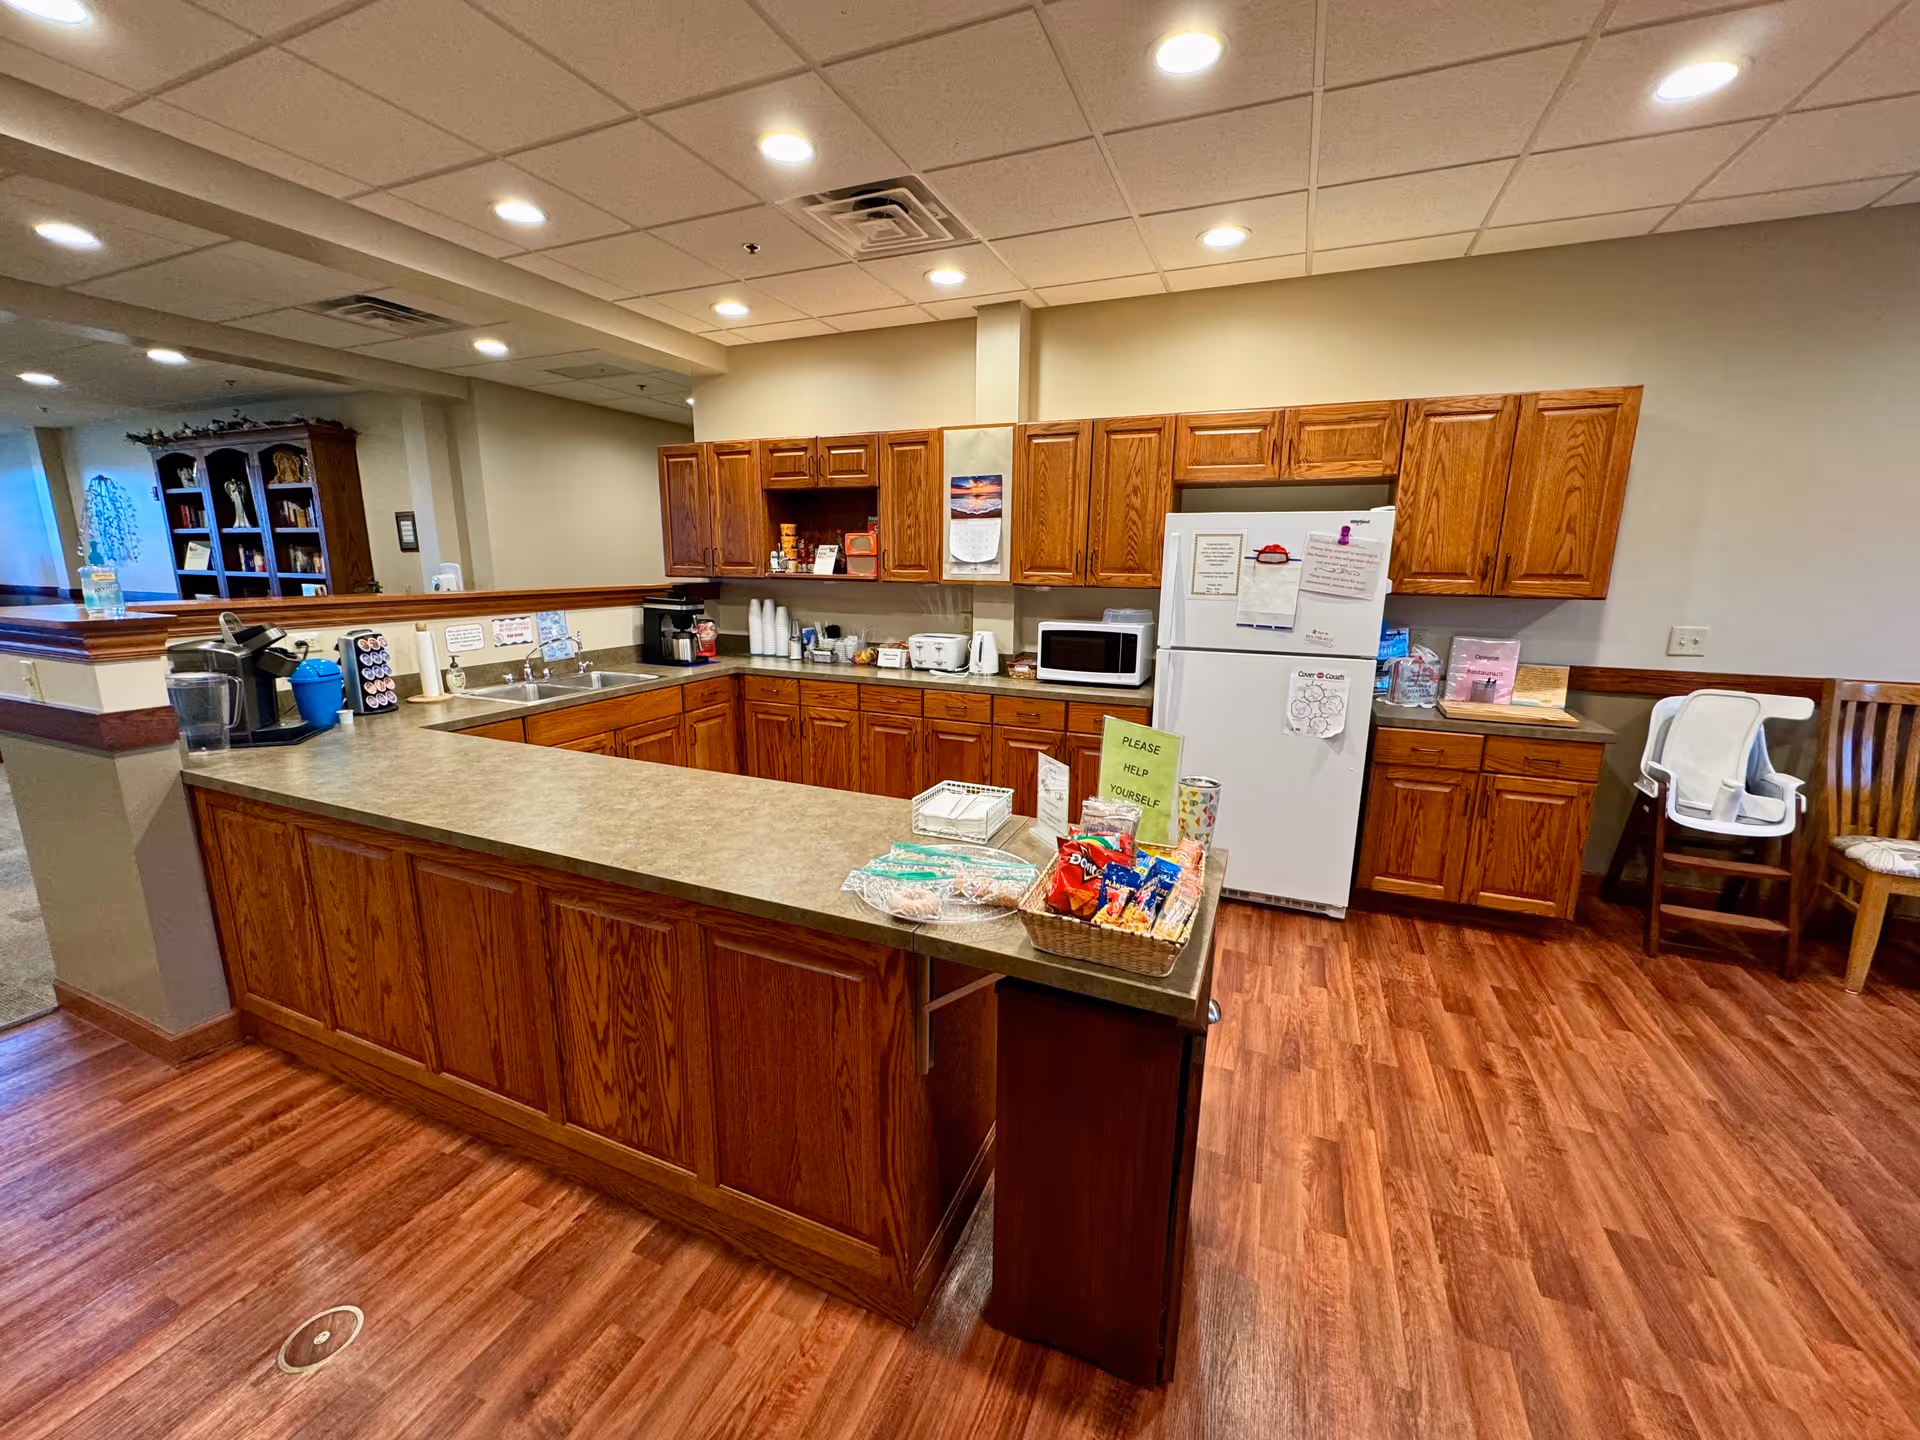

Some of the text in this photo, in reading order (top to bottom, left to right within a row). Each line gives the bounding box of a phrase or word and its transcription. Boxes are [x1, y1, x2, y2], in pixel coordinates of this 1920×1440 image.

[1298, 670, 1316, 678] Cover
[1325, 672, 1345, 680] Cough
[1122, 736, 1161, 755] PLEASE
[1123, 763, 1149, 777] HELP
[1110, 784, 1160, 808] YOURSELF
[1068, 853, 1104, 876] Dorito
